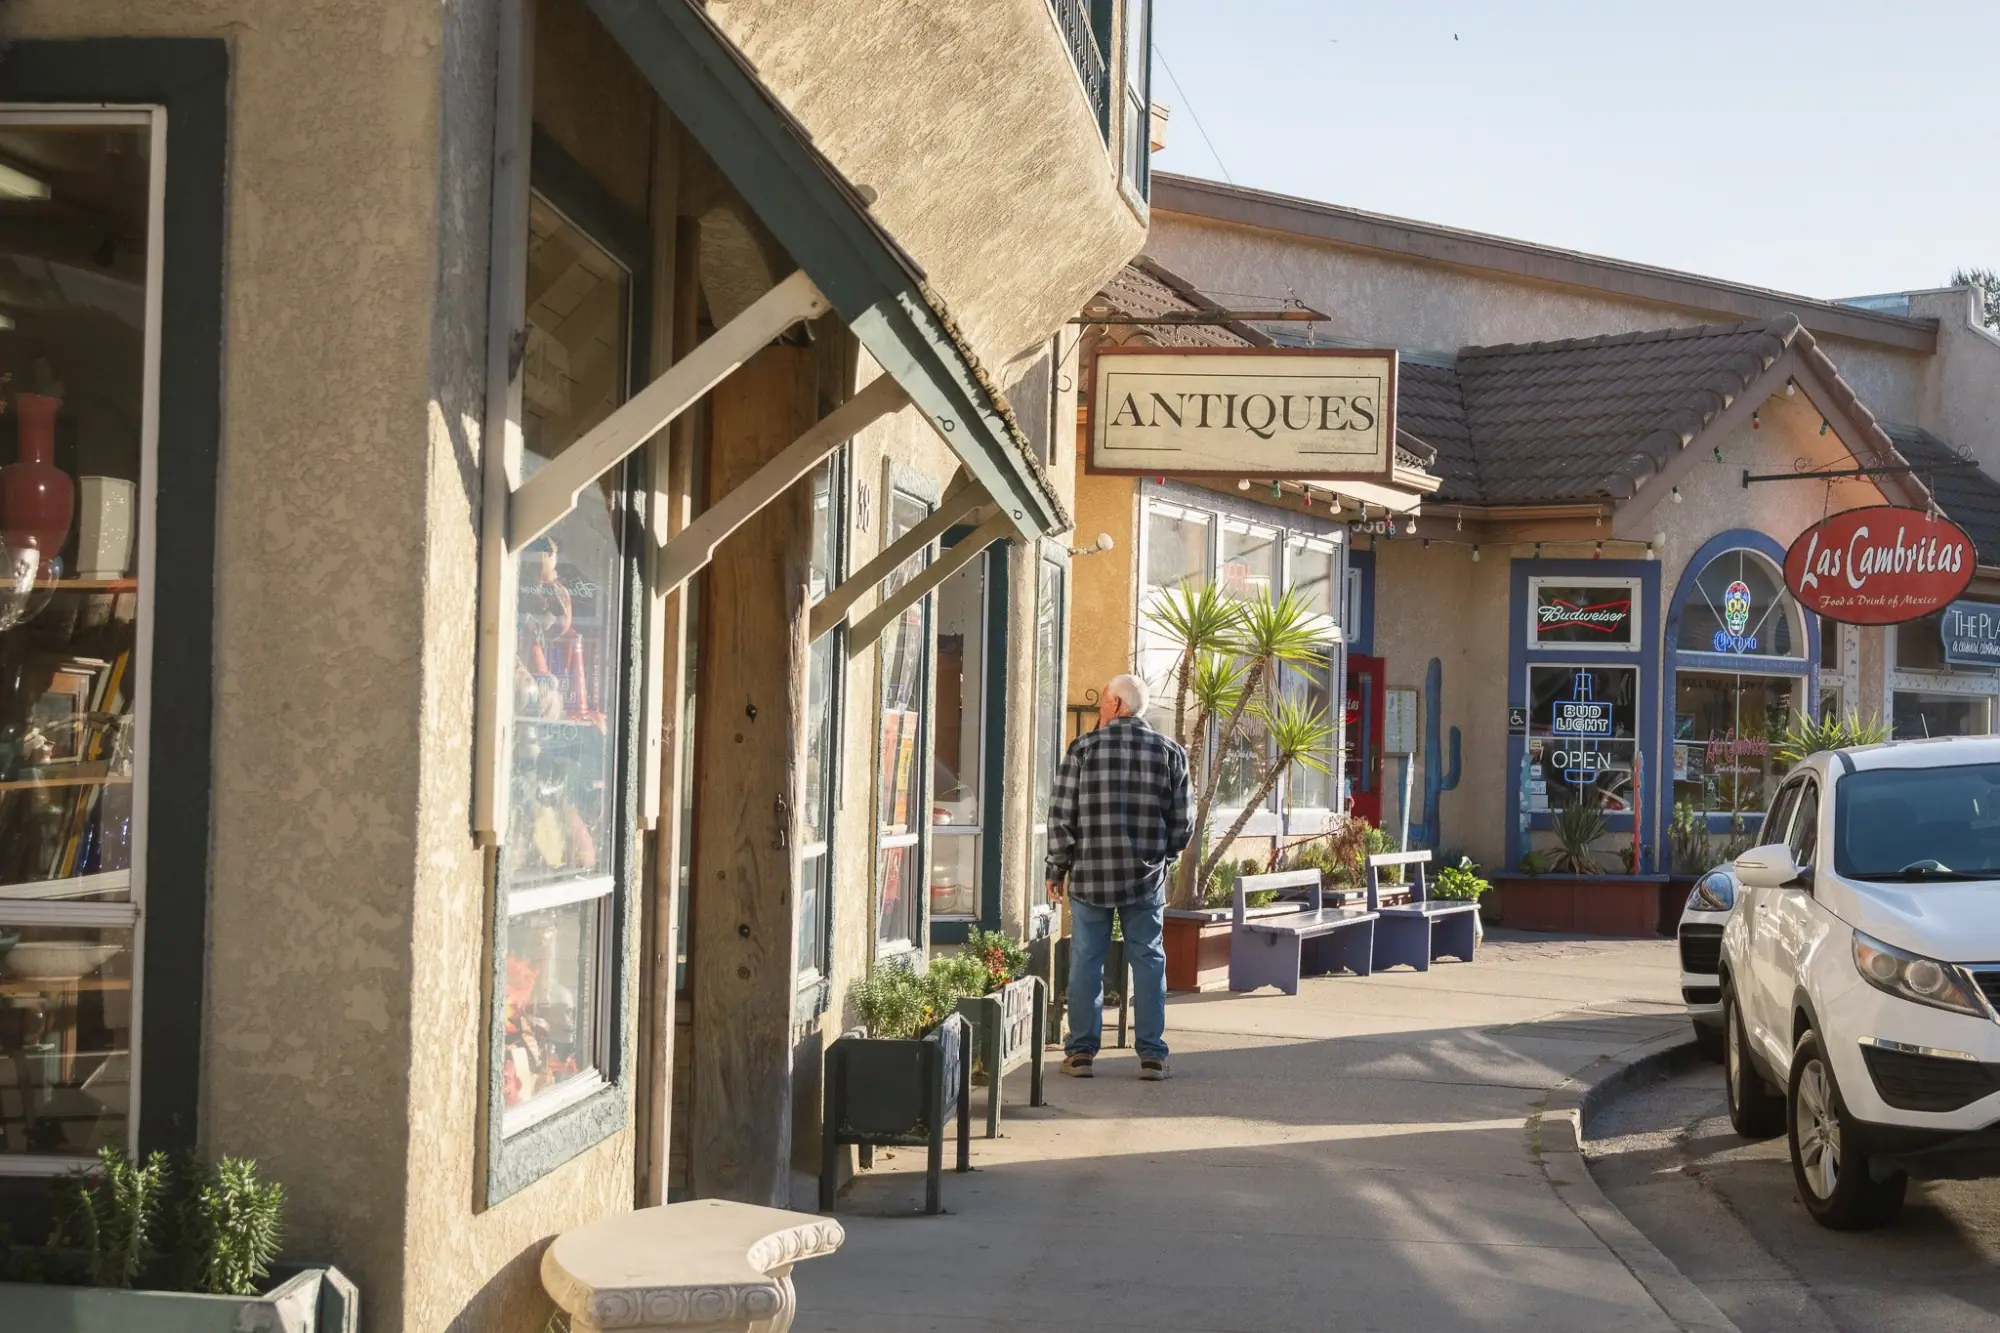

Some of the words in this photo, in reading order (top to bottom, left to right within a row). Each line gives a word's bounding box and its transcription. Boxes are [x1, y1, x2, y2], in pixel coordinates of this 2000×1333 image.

[1110, 392, 1375, 440] ANTIQUES
[1800, 531, 1842, 593] Las
[1846, 526, 1962, 589] Cambritas
[1819, 595, 1845, 608] Food
[1846, 597, 1854, 605] &
[1857, 594, 1885, 605] Drink
[1887, 595, 1898, 608] of
[1900, 594, 1937, 607] Mexico
[1538, 606, 1626, 622] Budweiser
[1951, 609, 1977, 638] THE
[1714, 630, 1757, 652] Corona
[1563, 704, 1602, 718] BUD
[1556, 717, 1609, 732] LIGHT
[1551, 750, 1611, 769] OPEN
